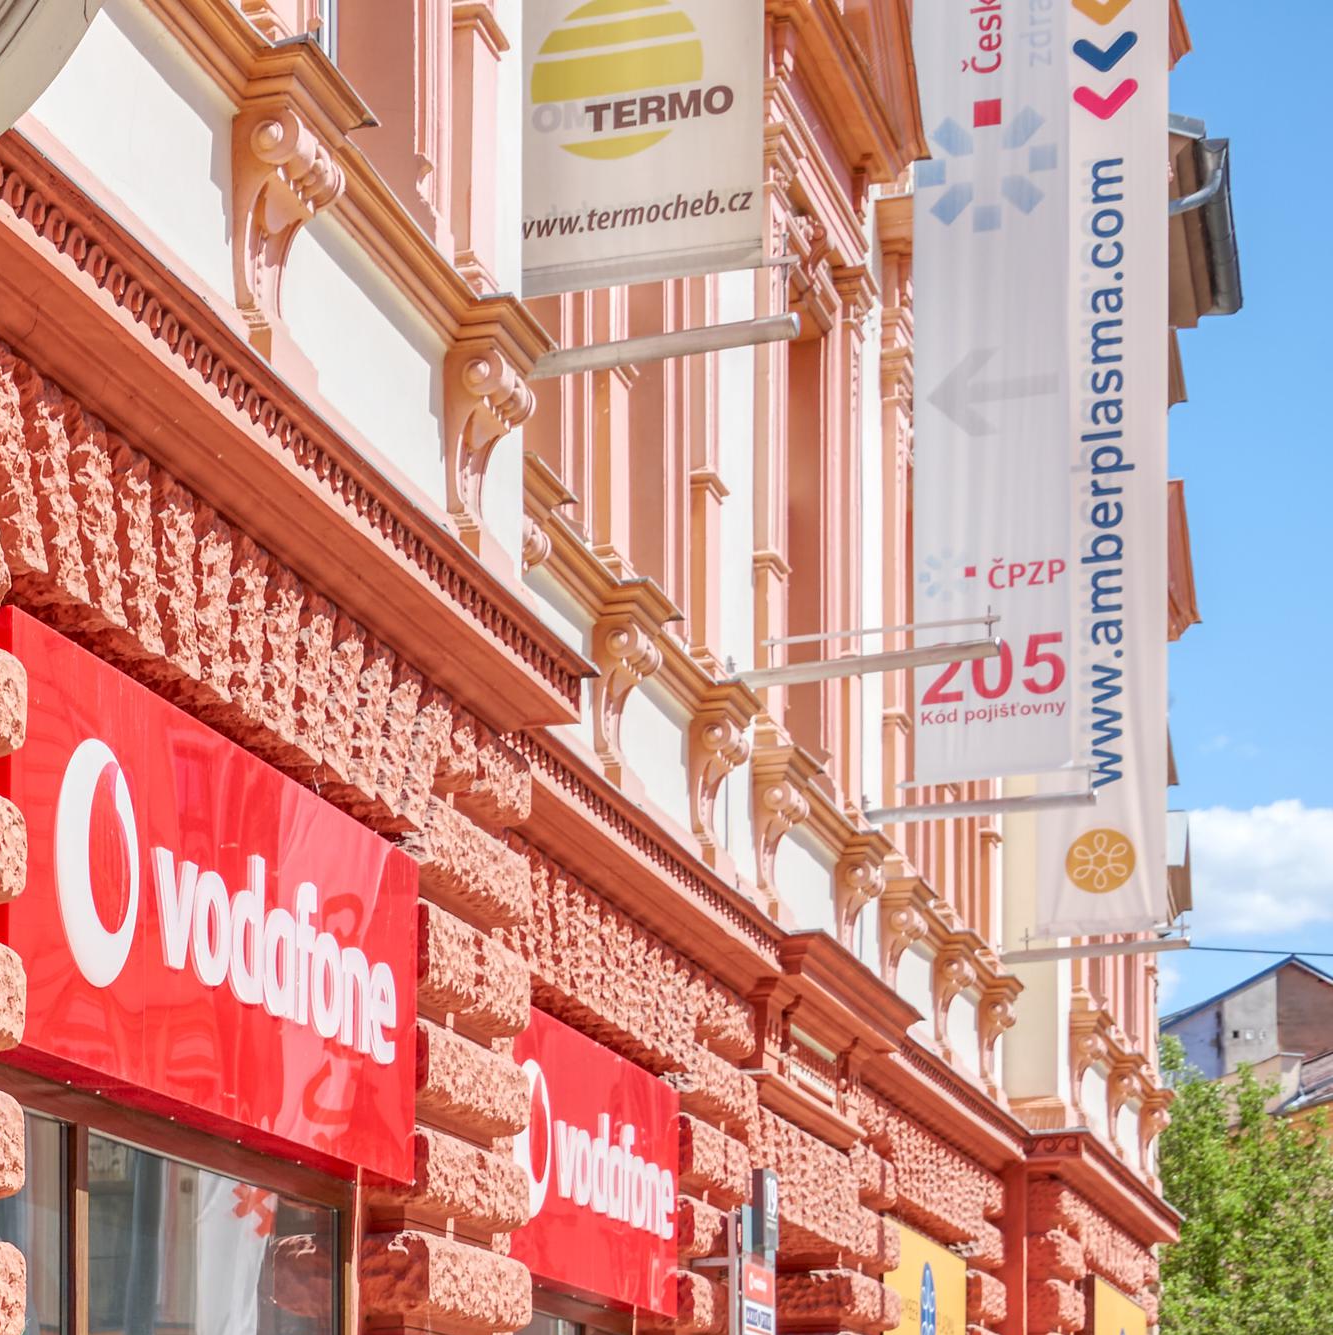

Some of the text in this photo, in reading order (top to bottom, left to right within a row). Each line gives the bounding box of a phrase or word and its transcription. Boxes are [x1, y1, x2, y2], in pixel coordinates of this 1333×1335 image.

[585, 85, 734, 132] TERMO
[1080, 156, 1135, 788] www.amberplasma.com
[988, 558, 1066, 589] ČPZP
[921, 632, 1066, 706] 205
[921, 701, 1066, 726] Kód pojišťovny
[150, 846, 397, 1066] vodafone
[553, 1113, 675, 1241] vodafone
